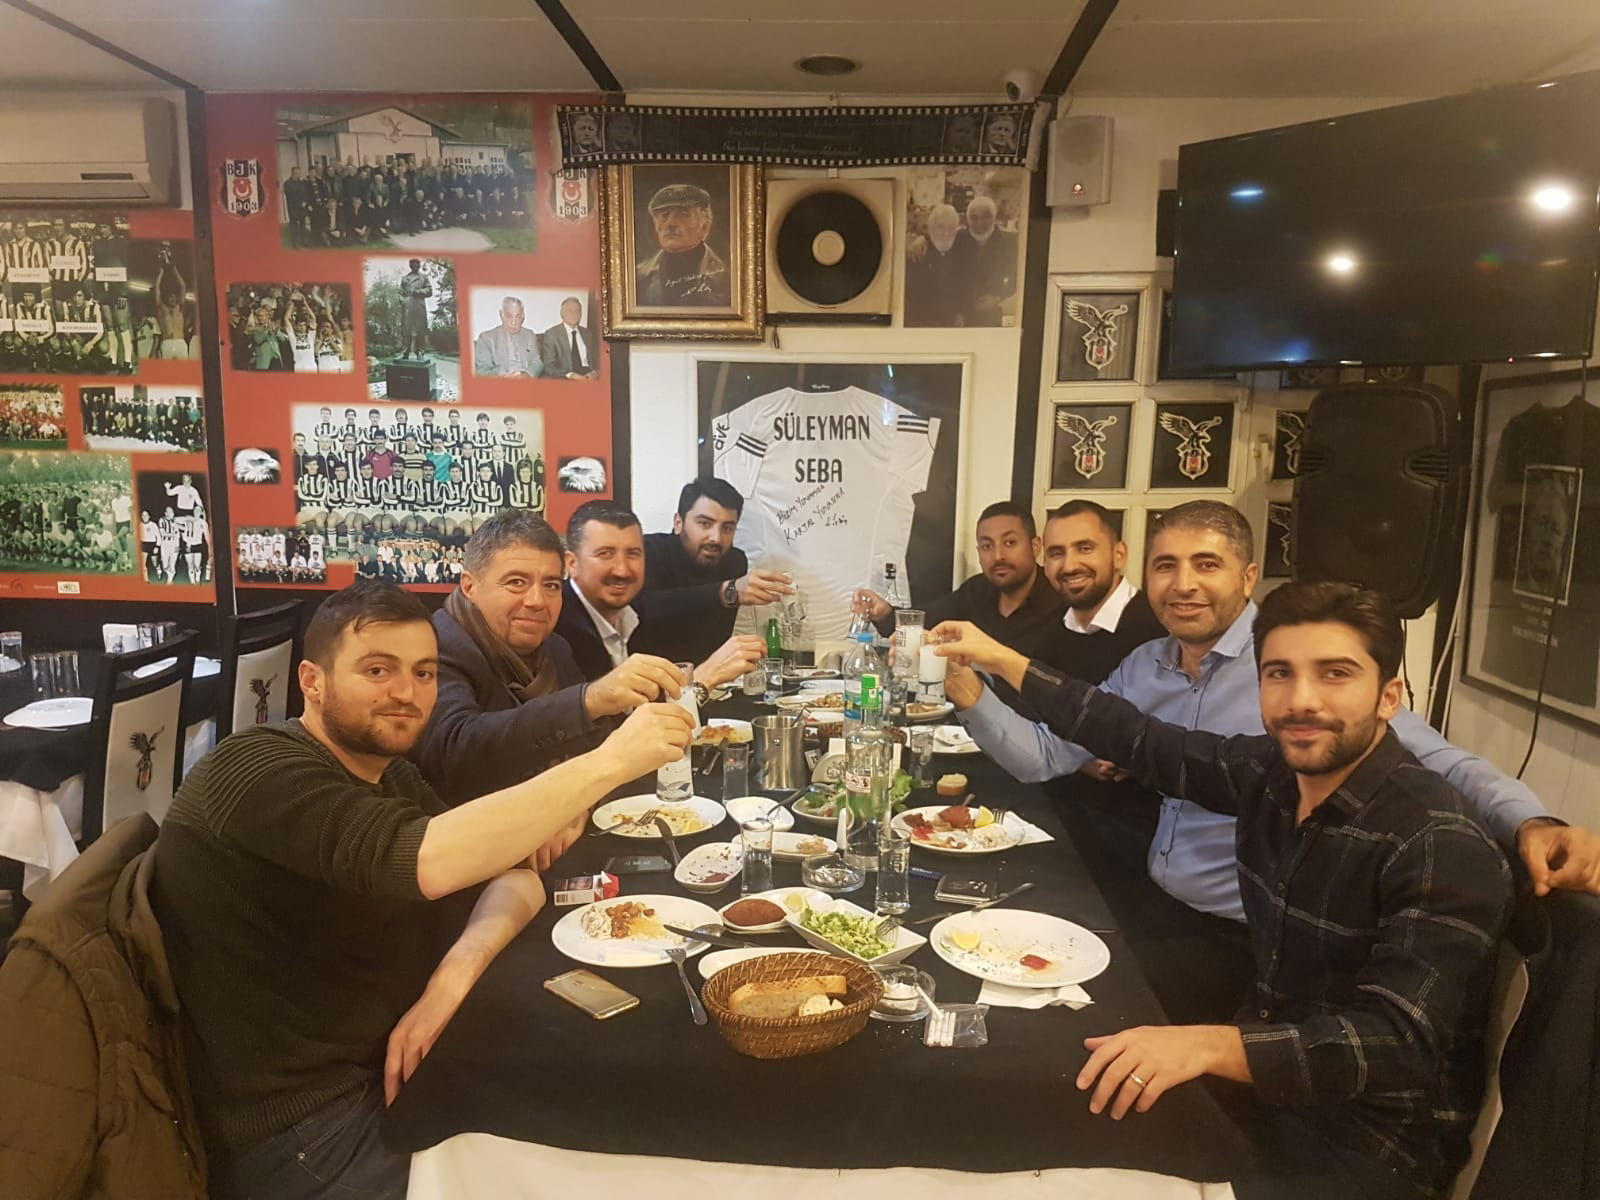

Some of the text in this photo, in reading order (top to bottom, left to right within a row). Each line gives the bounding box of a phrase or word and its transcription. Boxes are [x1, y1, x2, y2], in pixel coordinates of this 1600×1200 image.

[227, 163, 256, 176] BJK
[231, 201, 257, 211] 1903
[559, 205, 587, 216] 1903
[774, 412, 871, 441] SÜLEYMAN
[795, 458, 843, 483] SEBA
